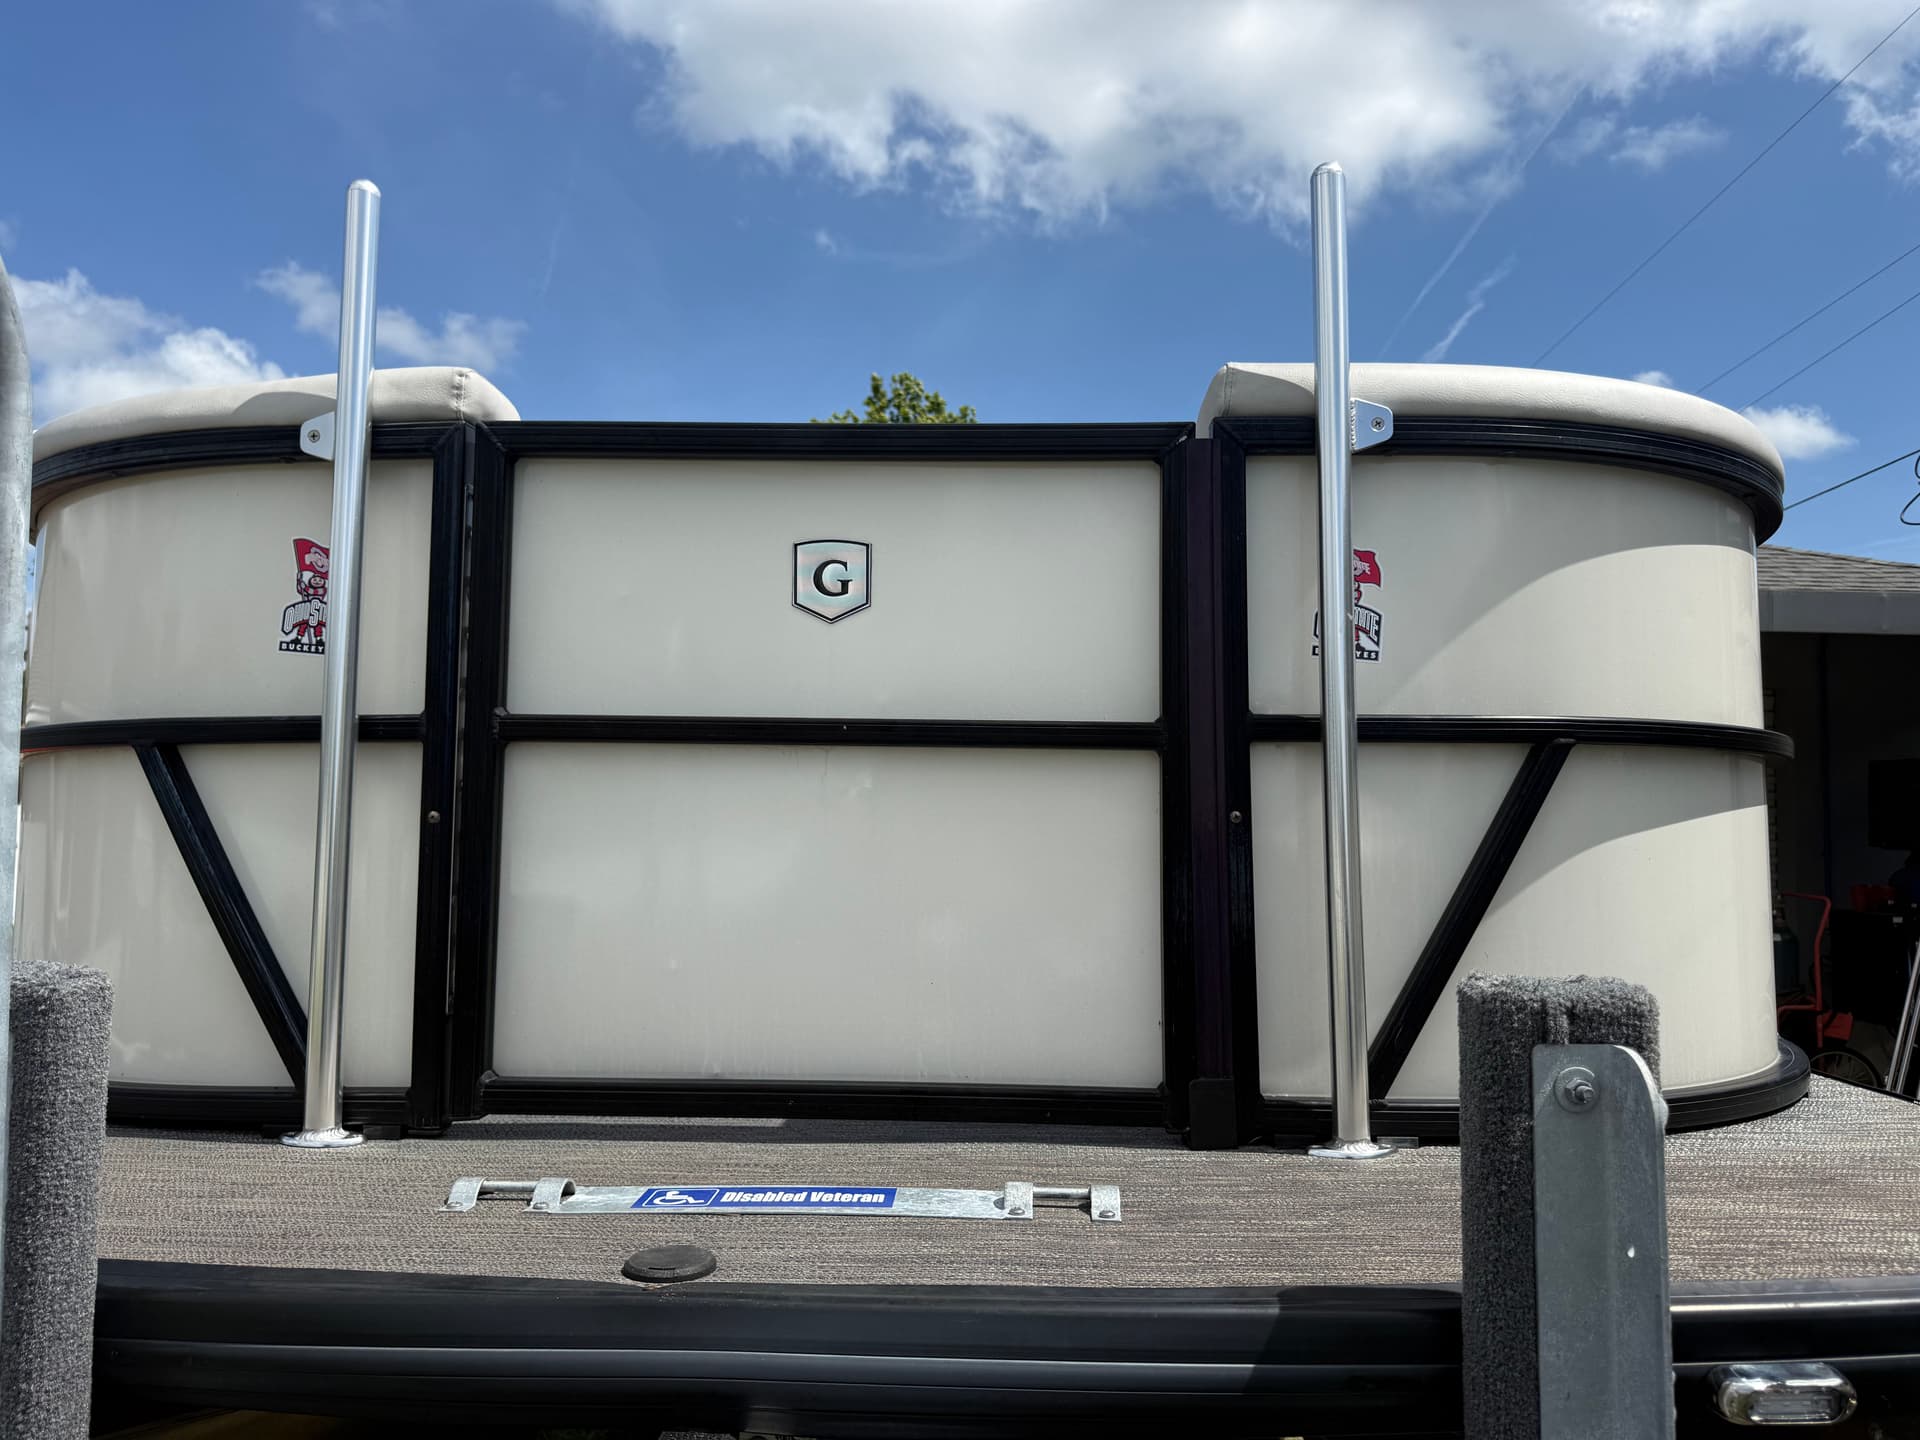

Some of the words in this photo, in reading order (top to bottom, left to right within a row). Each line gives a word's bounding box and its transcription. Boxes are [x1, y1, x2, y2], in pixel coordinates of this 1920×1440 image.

[813, 559, 853, 597] G
[281, 642, 324, 653] BUCKEY
[721, 1191, 808, 1203] Disabled
[810, 1191, 886, 1204] Veteran
